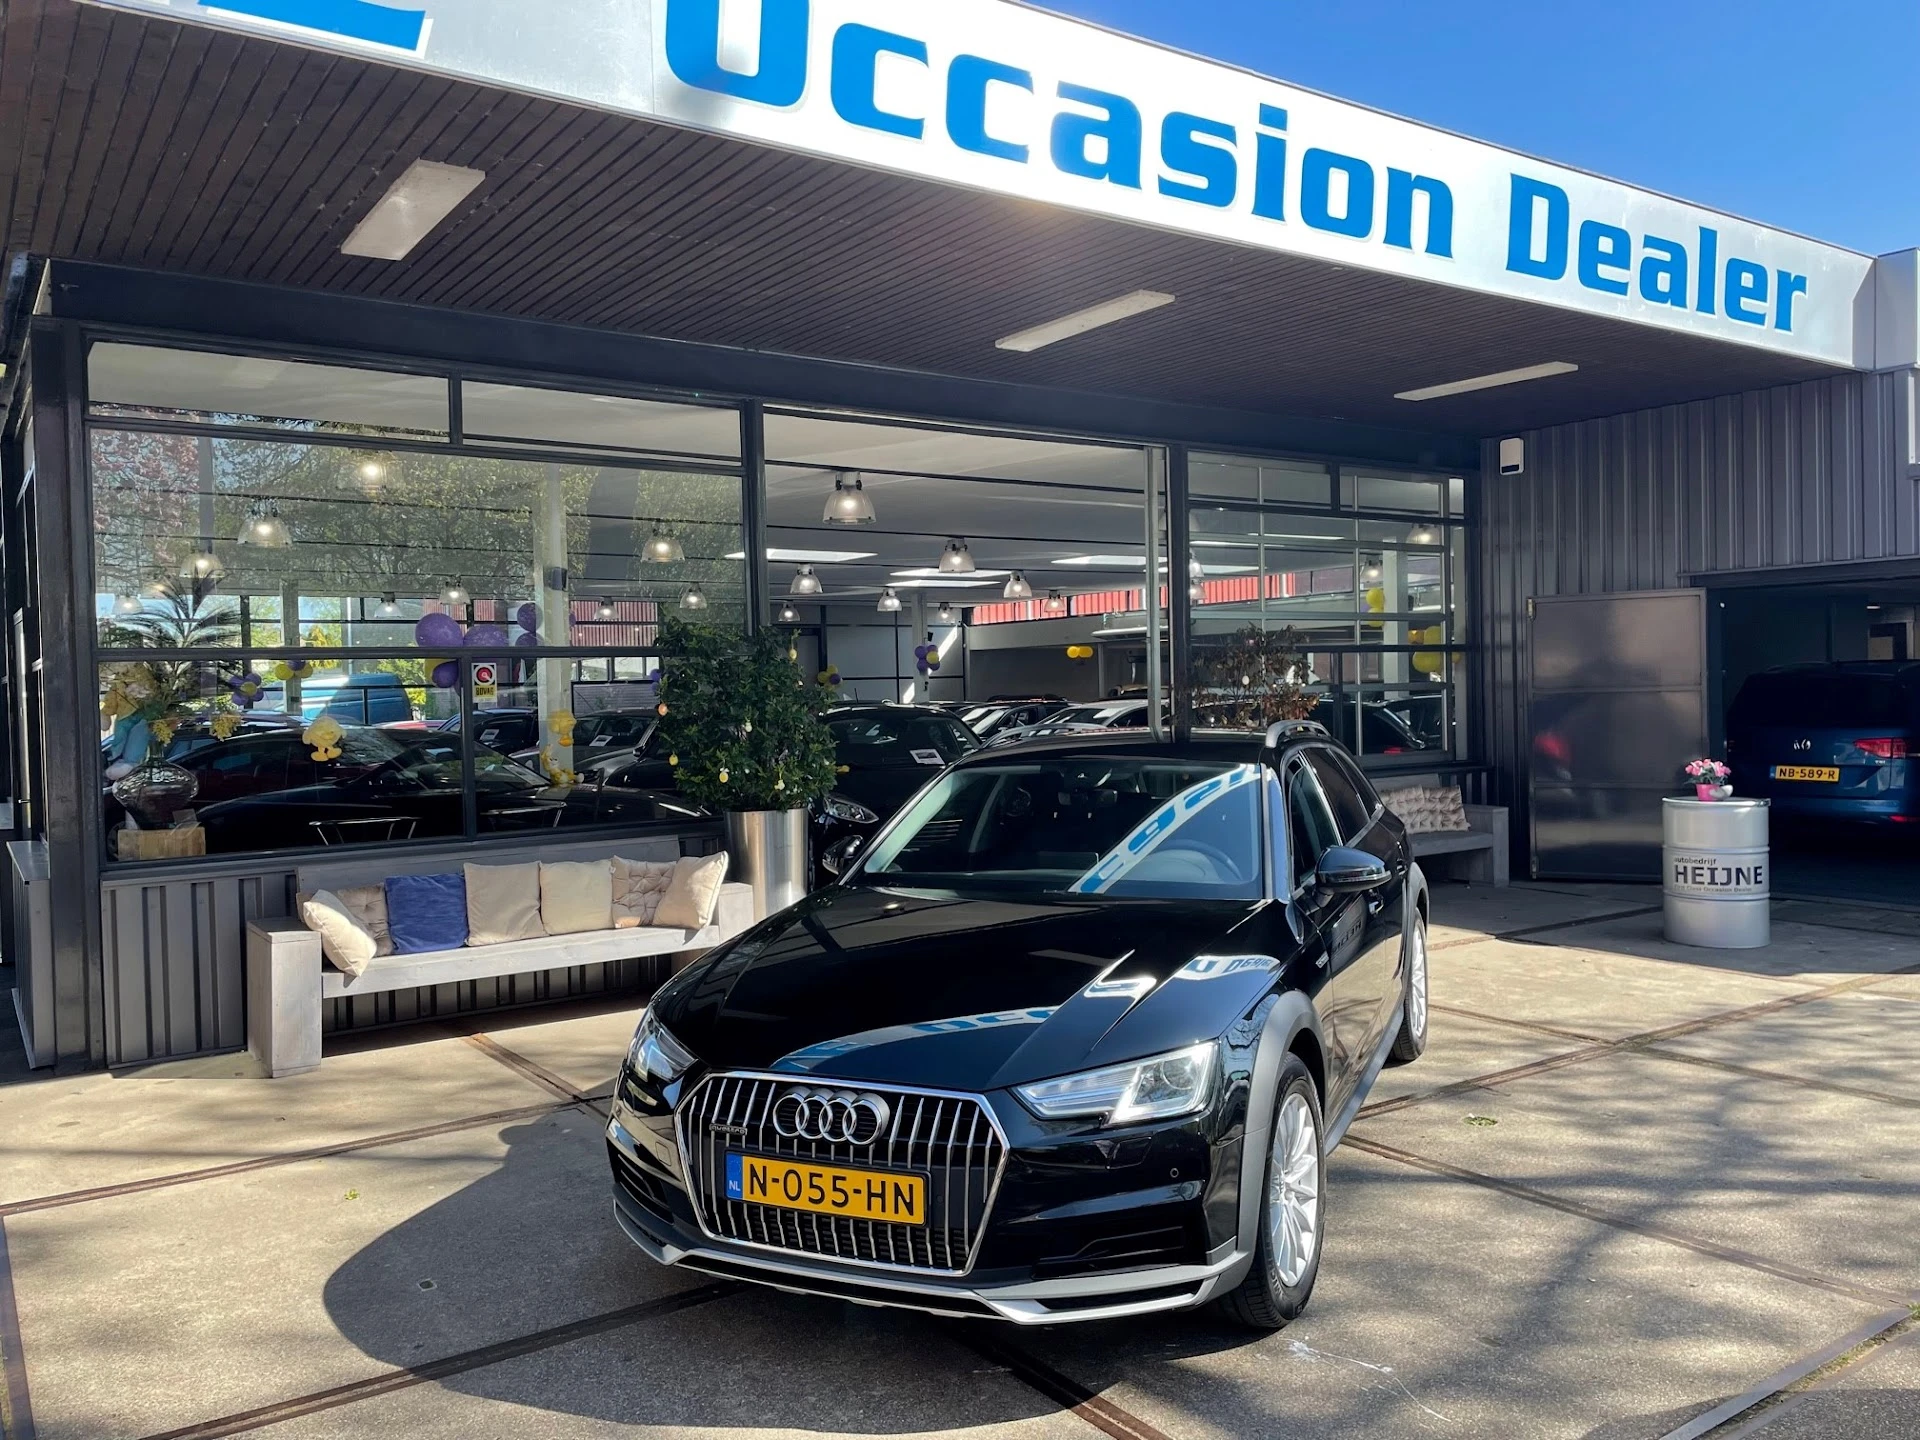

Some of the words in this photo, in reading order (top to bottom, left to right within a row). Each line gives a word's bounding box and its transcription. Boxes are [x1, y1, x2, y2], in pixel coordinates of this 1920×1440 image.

[665, 0, 1454, 259] Occasion
[1506, 173, 1807, 332] Dealer
[1779, 768, 1835, 780] NB-589-R
[1674, 857, 1717, 866] autobedrijf
[1674, 865, 1763, 886] HEIJNE
[728, 1179, 741, 1192] NL
[749, 1164, 915, 1216] N-055-HN
